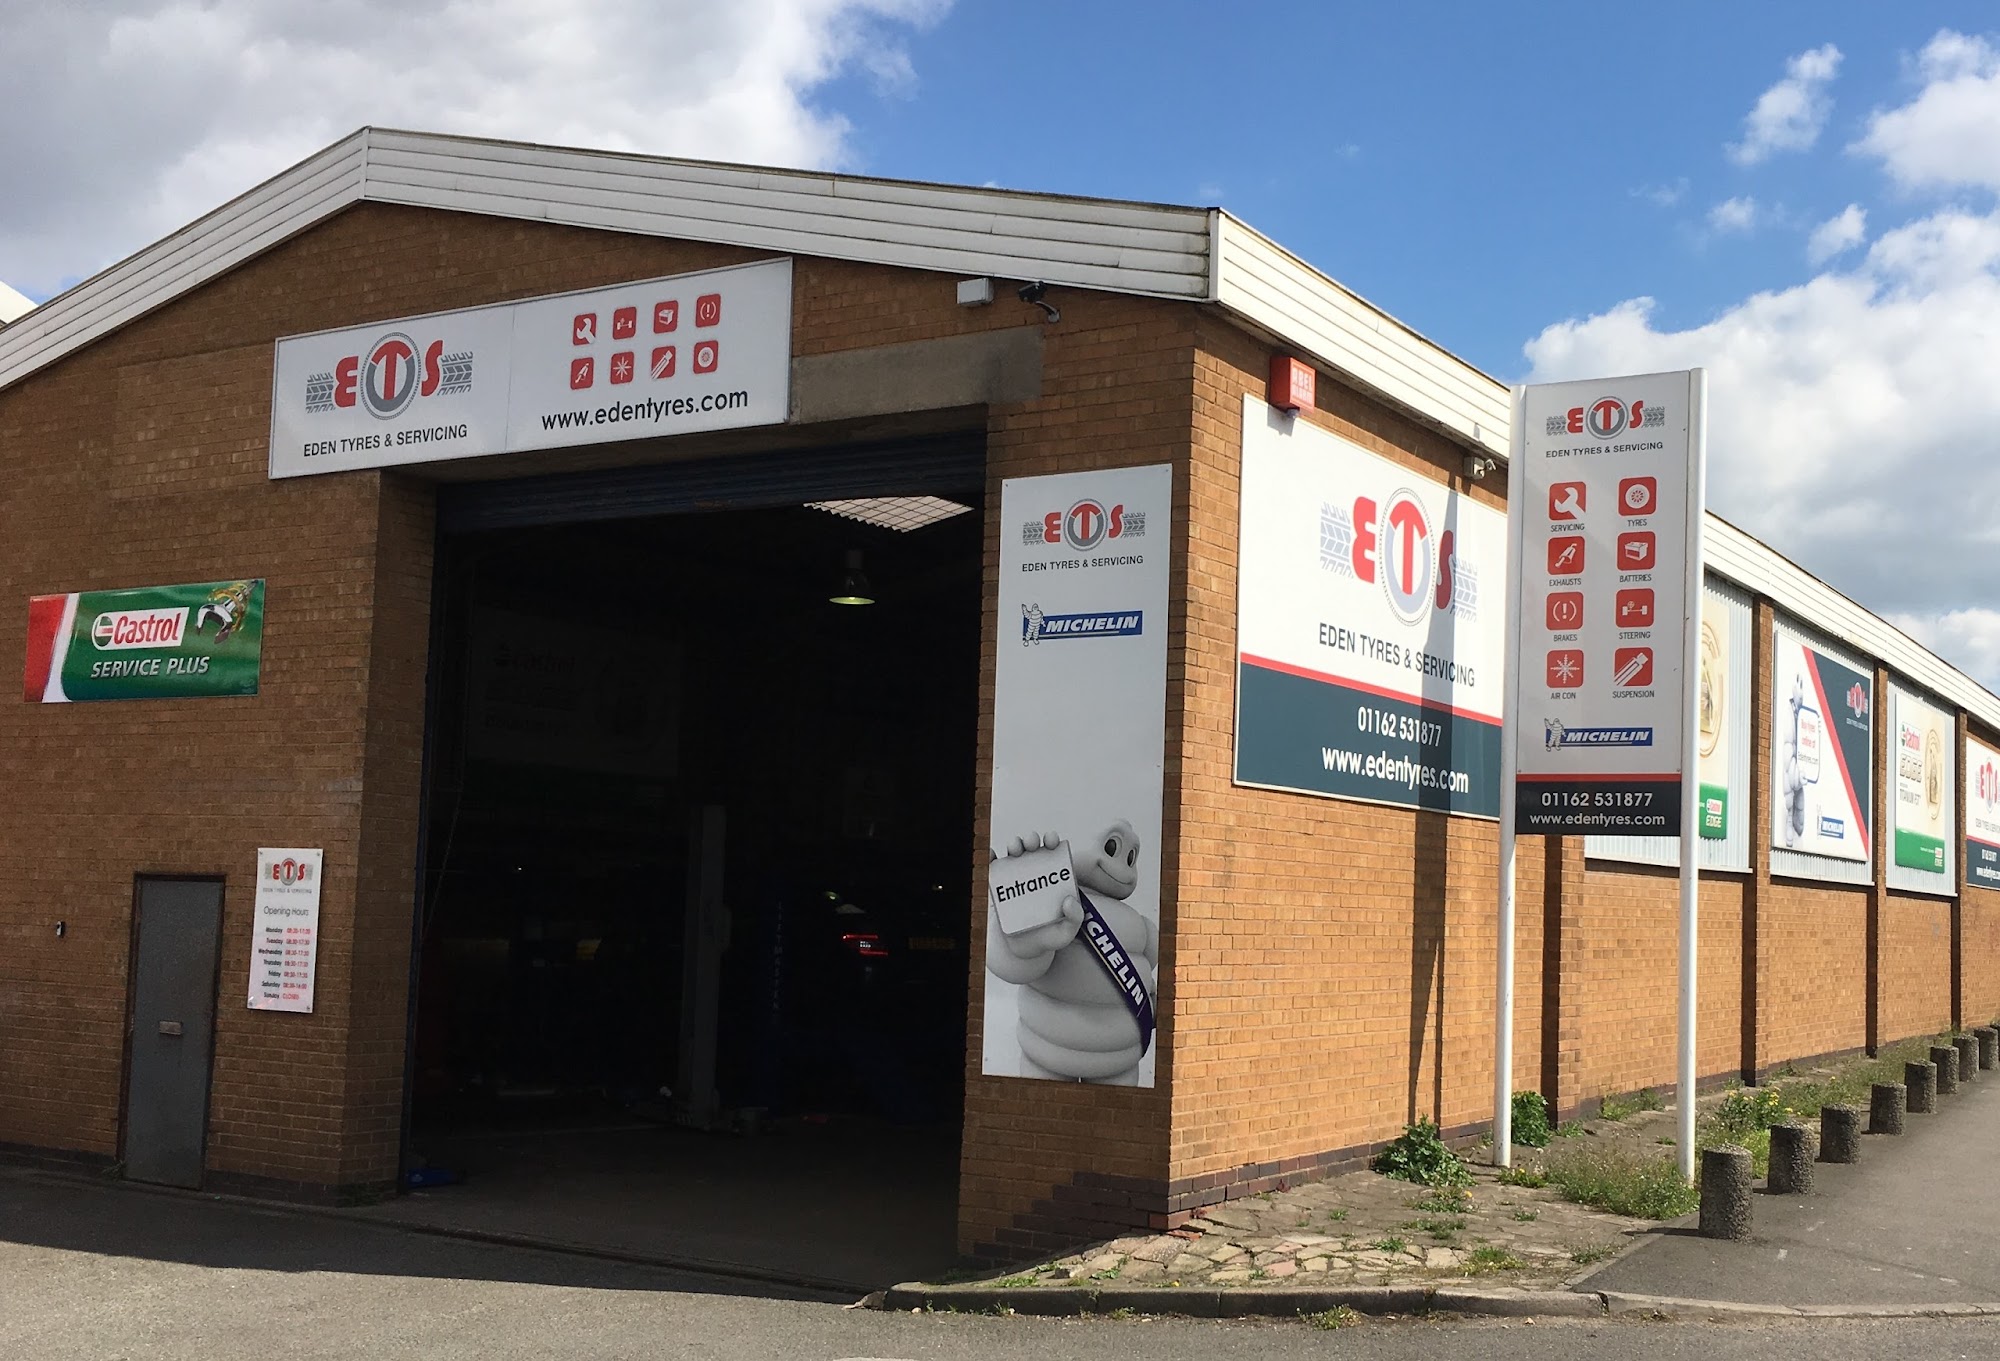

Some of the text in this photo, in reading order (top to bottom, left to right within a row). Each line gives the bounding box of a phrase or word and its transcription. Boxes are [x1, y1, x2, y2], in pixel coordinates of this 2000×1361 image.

[334, 339, 443, 408] ETS
[541, 390, 748, 431] www.edentyres.com
[1567, 400, 1644, 434] ETS
[303, 424, 468, 457] EDEN TYRES & SERVICING
[1546, 441, 1663, 458] EDEN TYRES & SERVICING
[1044, 503, 1124, 543] ETS
[1550, 523, 1585, 532] SERVICING
[1627, 519, 1647, 527] TYRES
[1352, 496, 1454, 609] ETS
[1022, 555, 1144, 572] EDEN TYRES & SERVICING
[1549, 578, 1582, 586] EXHAUSTS
[1619, 574, 1652, 583] BATTERIES
[114, 611, 182, 645] Castrol
[1046, 615, 1139, 633] MICHELIN
[1553, 634, 1577, 642] BRAKES
[1619, 631, 1651, 640] STEERING
[1319, 622, 1475, 687] EDEN TYRES & SERVICING
[90, 656, 210, 678] SERVICE PLUS
[1562, 692, 1576, 700] CON
[1612, 690, 1655, 699] SUSPENSION
[1357, 706, 1442, 747] 01162 531877
[1566, 730, 1649, 742] MICHELIN
[1322, 747, 1469, 793] www.edentyres.com
[1541, 792, 1653, 807] 01162 531877
[1530, 812, 1665, 827] www.edentyres.com
[273, 860, 306, 881] ETS
[996, 867, 1071, 902] Entrance
[263, 905, 309, 917] Opening Hours
